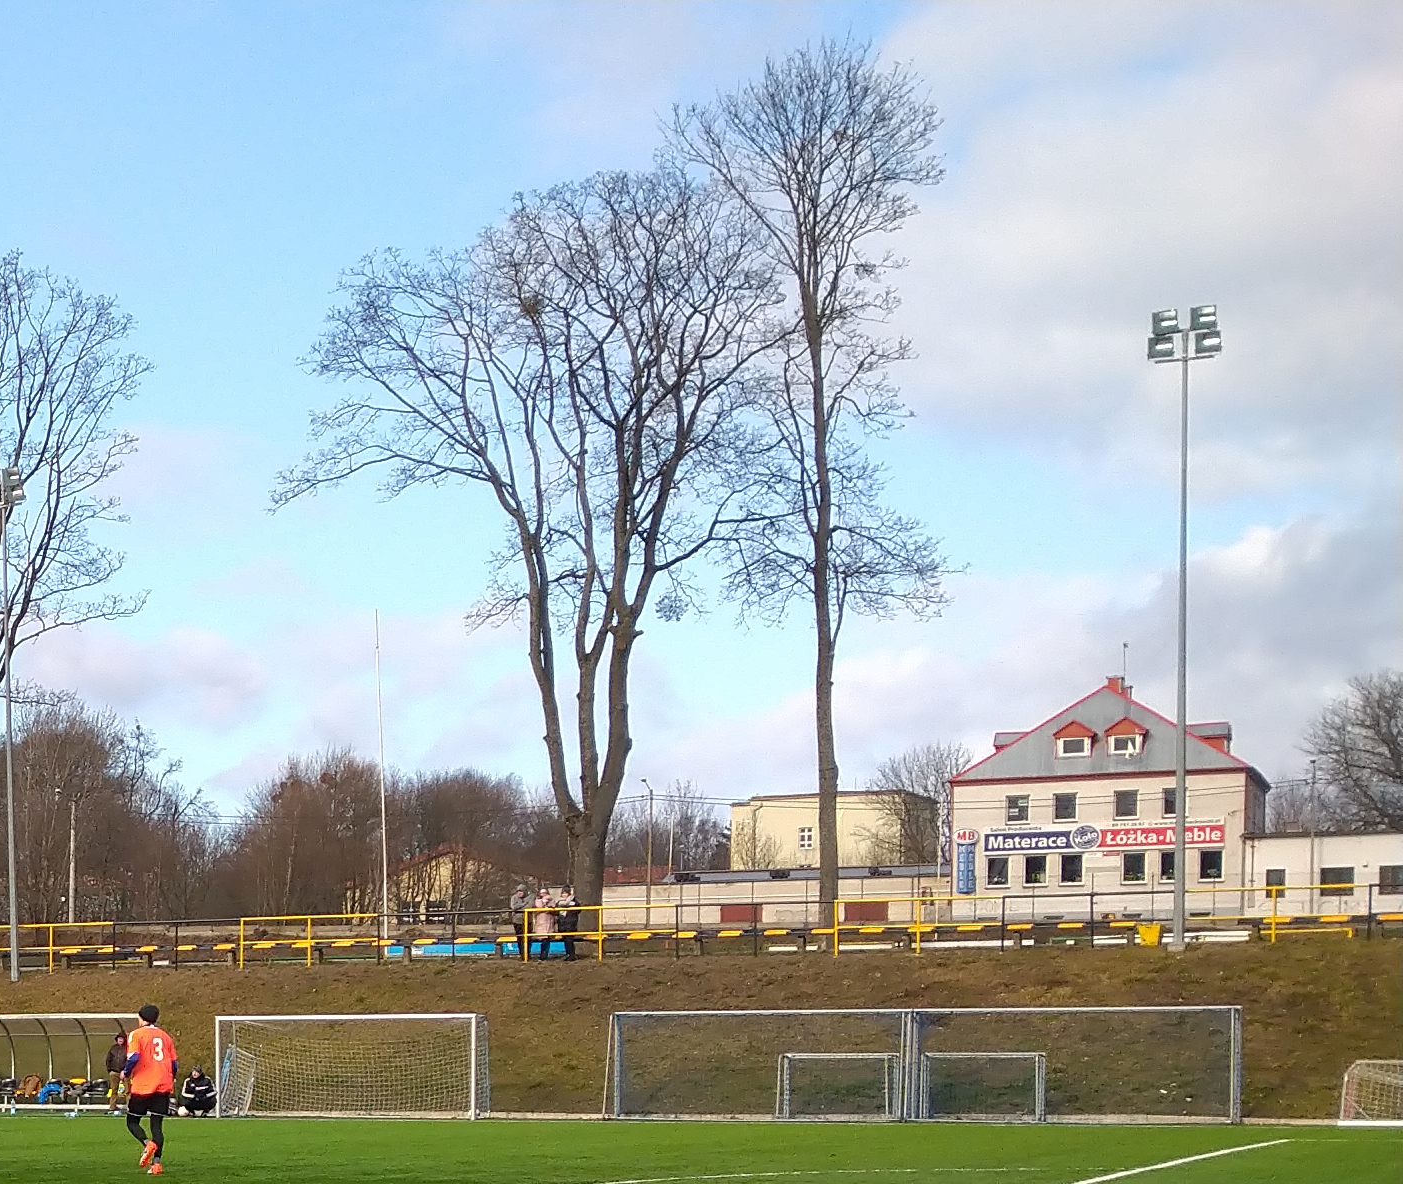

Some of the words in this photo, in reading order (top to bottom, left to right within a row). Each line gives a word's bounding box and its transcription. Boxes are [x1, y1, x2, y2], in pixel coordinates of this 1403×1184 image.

[957, 831, 975, 841] MB
[987, 836, 1067, 849] Materace
[1105, 830, 1157, 845] Łóżka
[152, 1037, 164, 1062] 3
